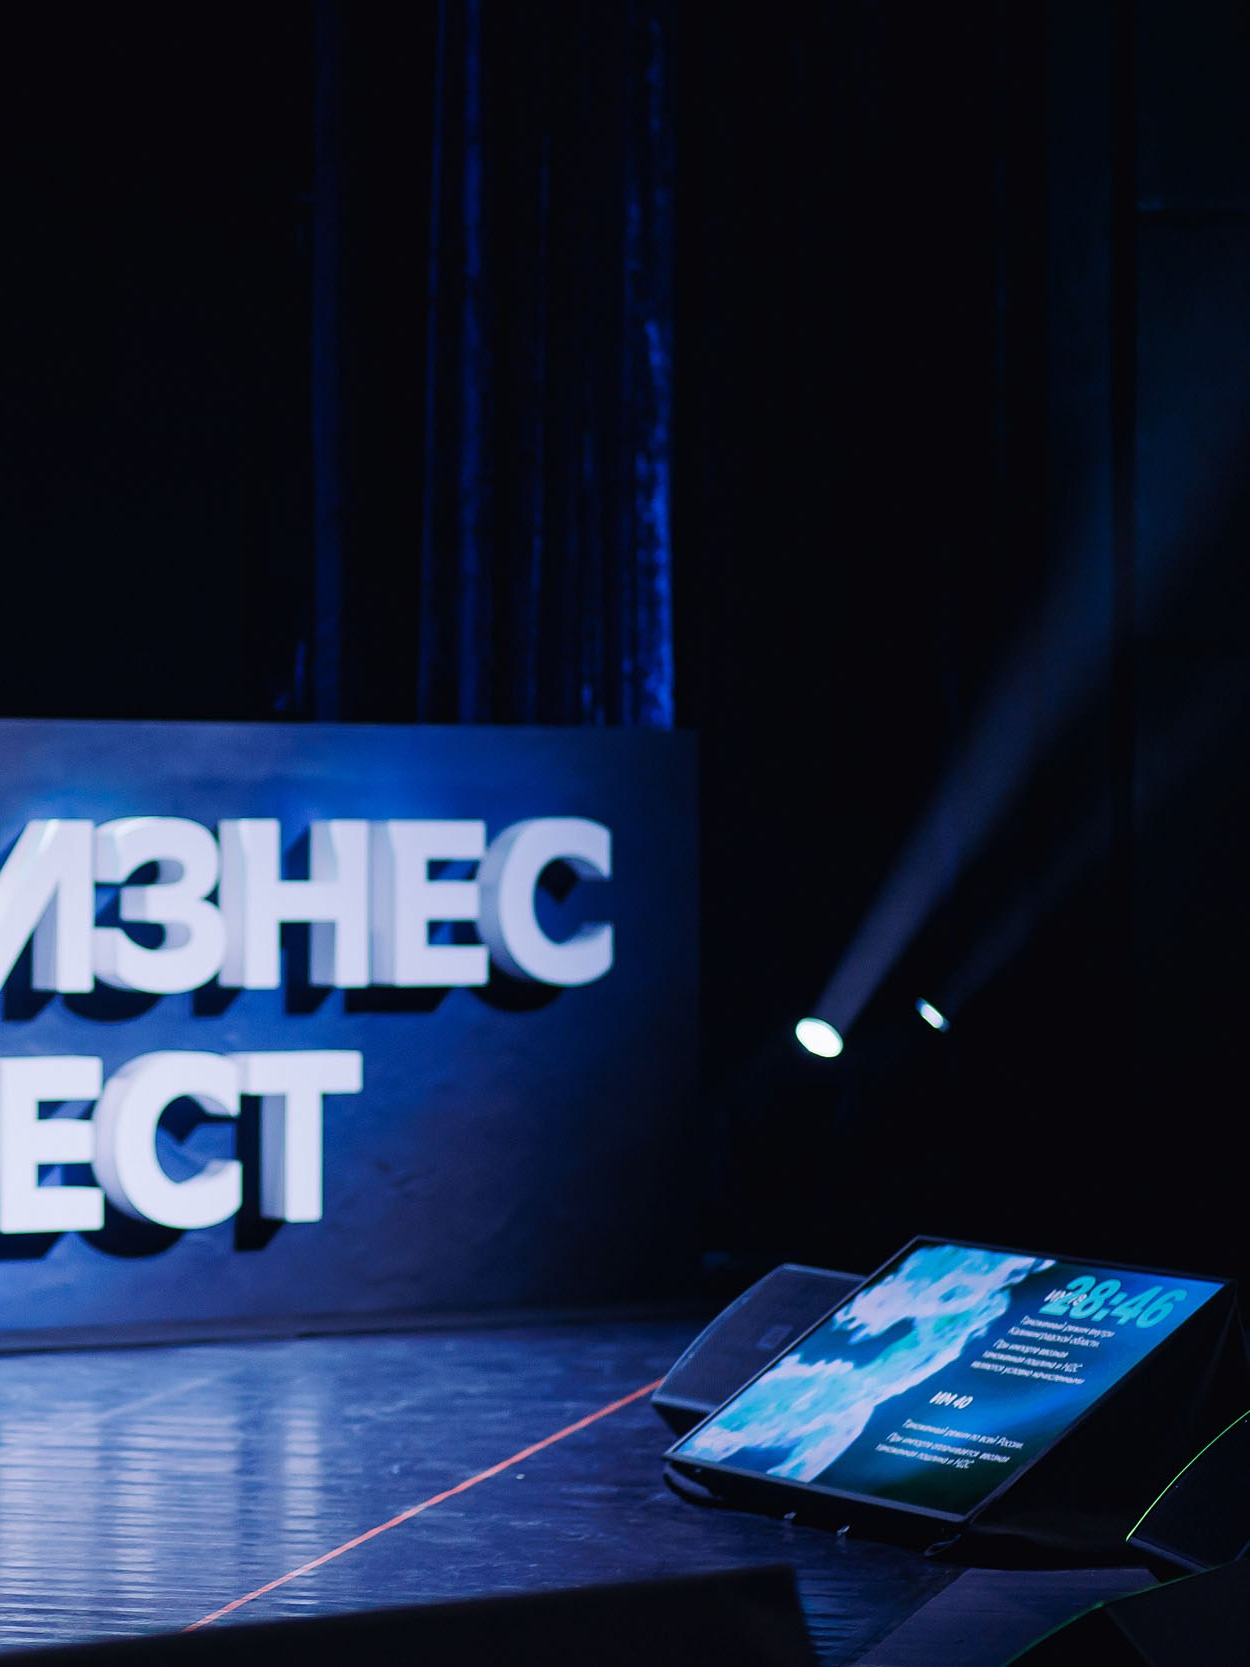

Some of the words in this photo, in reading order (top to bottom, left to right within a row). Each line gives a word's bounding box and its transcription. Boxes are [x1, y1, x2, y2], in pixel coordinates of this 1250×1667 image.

[1038, 1275, 1188, 1329] 28:46
[930, 1392, 957, 1406] ИМ
[953, 1396, 973, 1409] 40
